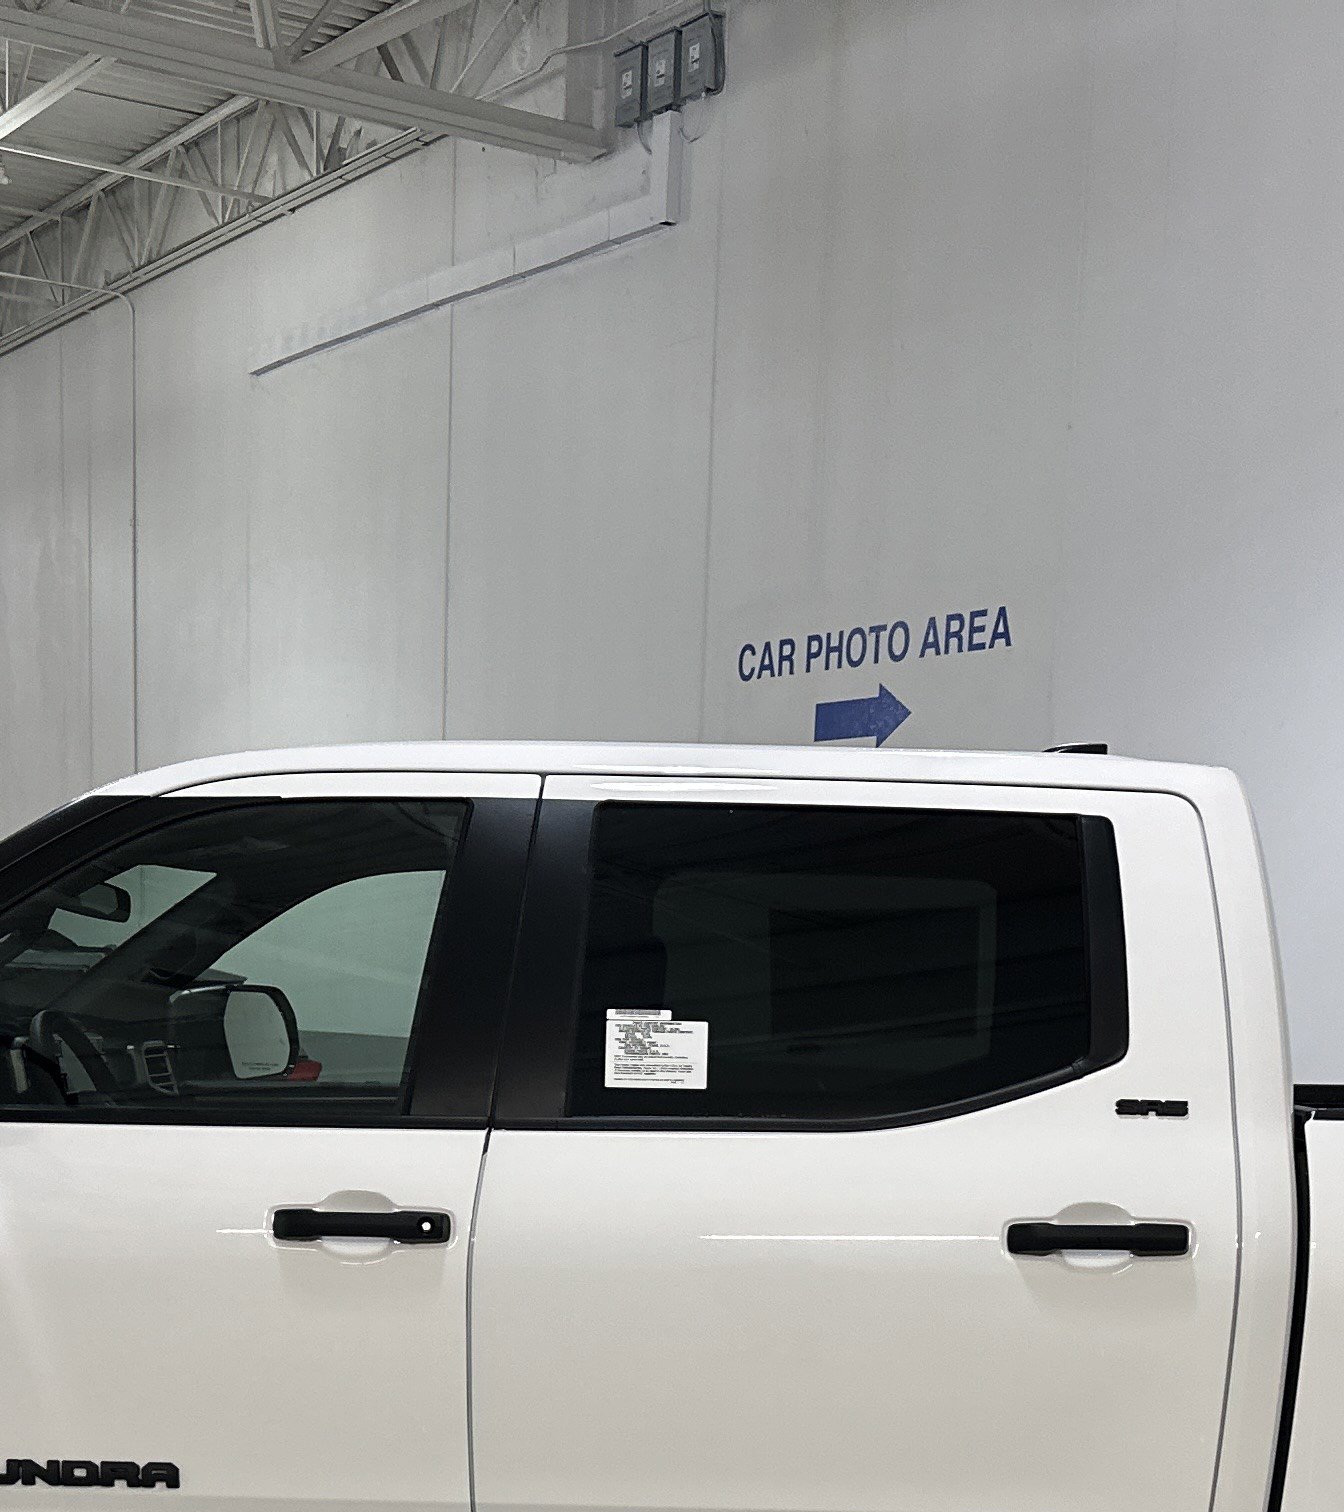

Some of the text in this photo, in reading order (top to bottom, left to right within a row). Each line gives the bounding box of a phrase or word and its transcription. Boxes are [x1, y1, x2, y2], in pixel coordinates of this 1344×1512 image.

[738, 605, 1012, 682] CAR PHOTO AREA
